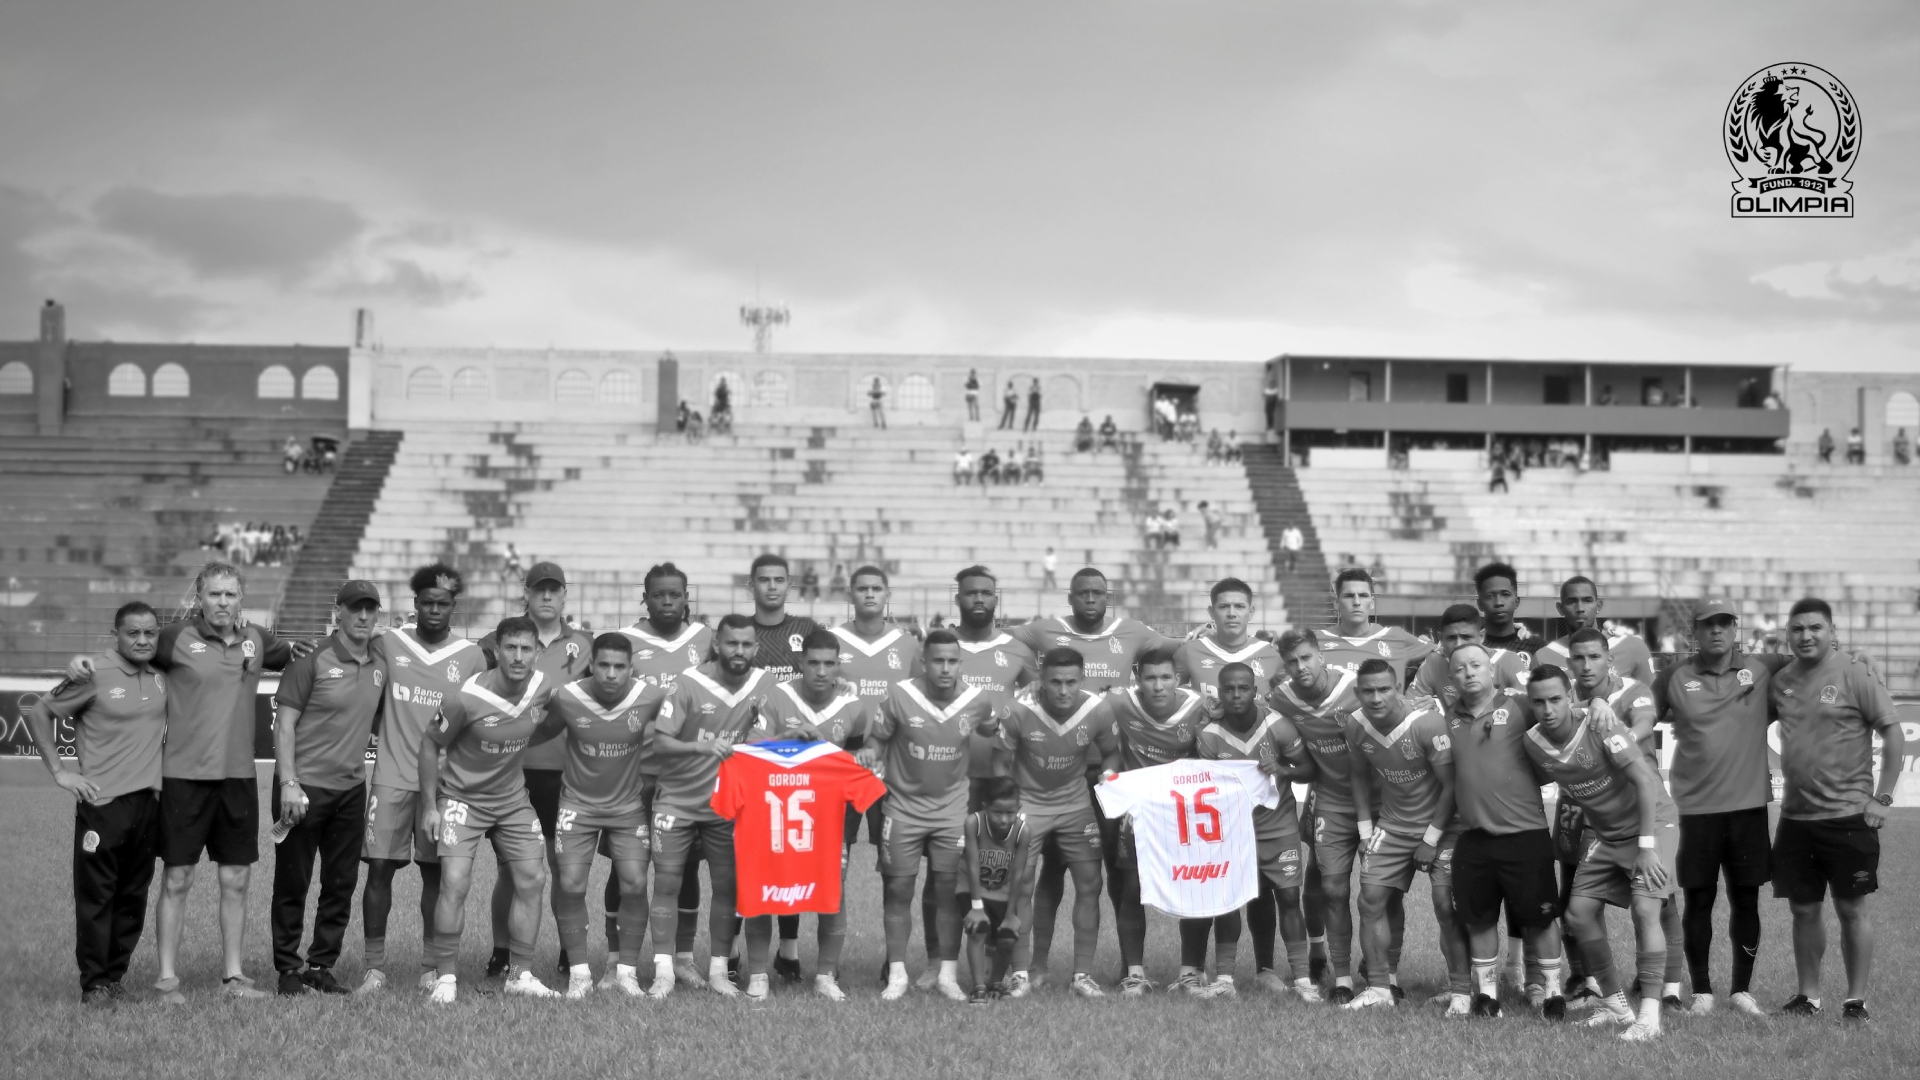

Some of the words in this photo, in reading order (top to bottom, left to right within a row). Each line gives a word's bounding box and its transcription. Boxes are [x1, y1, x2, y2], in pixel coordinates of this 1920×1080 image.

[1084, 662, 1108, 670] anco
[1084, 668, 1121, 678] tlántida
[860, 679, 888, 689] Banco
[962, 674, 992, 684] Banco
[413, 686, 443, 699] Banco
[860, 686, 887, 696] Atlán
[598, 742, 629, 751] Banco
[928, 744, 956, 754] Banco
[443, 799, 469, 825] 25
[1170, 786, 1224, 845] 15
[1560, 803, 1582, 830] 27
[765, 790, 816, 853] 15
[980, 866, 1007, 887] 23
